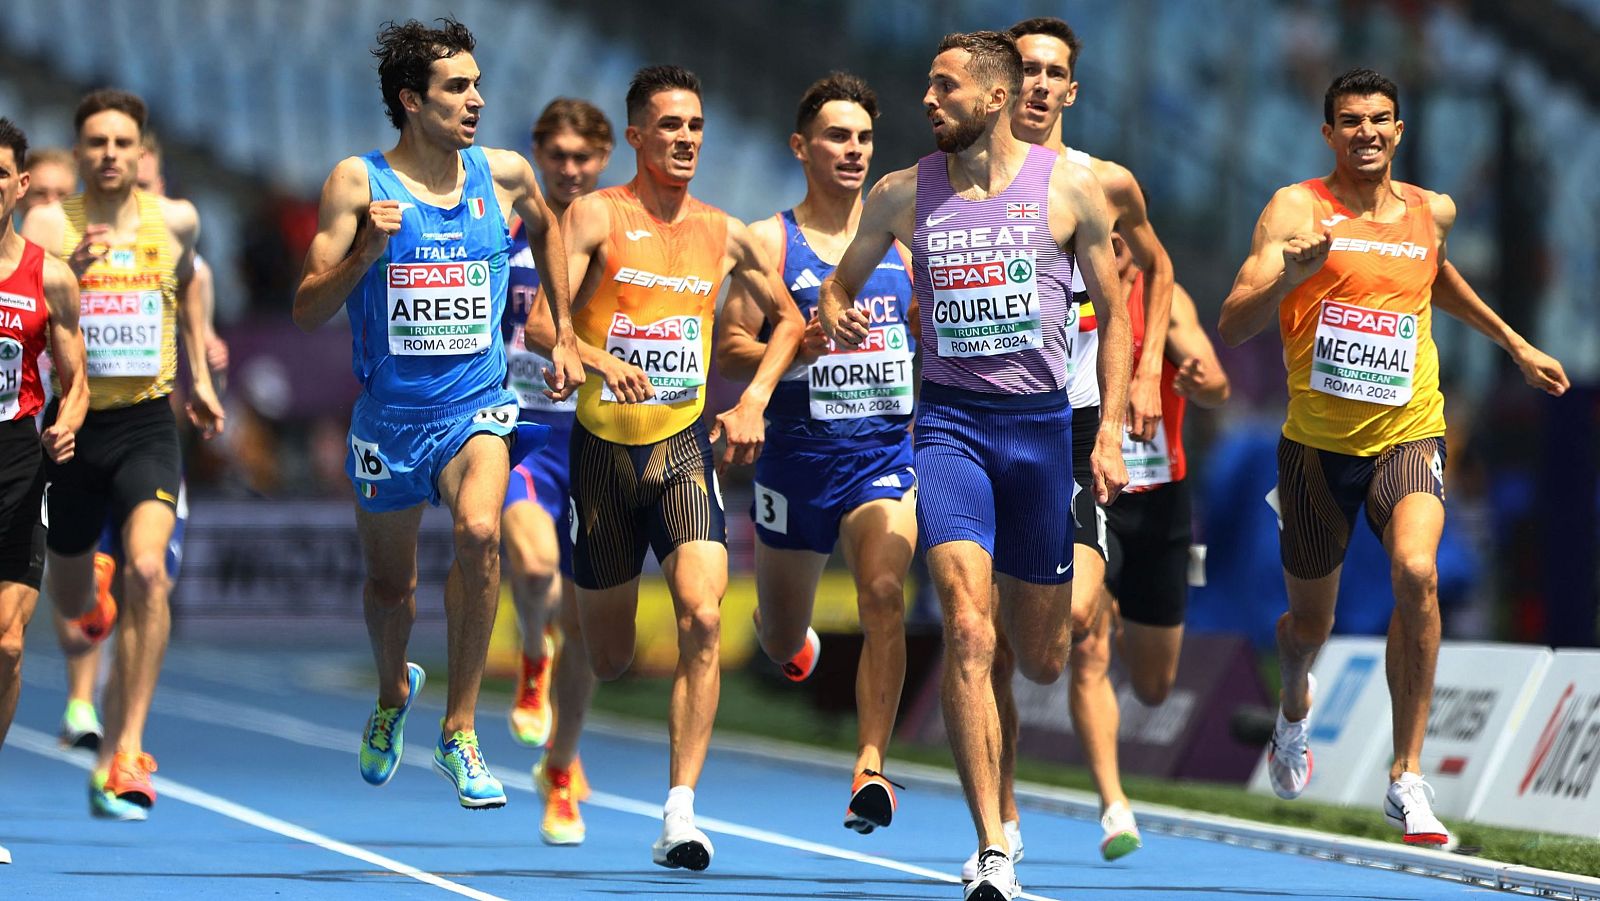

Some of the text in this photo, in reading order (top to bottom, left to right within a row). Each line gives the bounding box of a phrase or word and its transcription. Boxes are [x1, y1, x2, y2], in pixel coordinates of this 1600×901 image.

[928, 226, 1036, 252] GREAT
[1330, 238, 1428, 261] ESPAÑA
[415, 246, 468, 259] ITALIA
[391, 267, 463, 285] SPAR
[613, 267, 713, 296] ESPAÑA
[933, 265, 1004, 287] SPAR
[391, 297, 487, 321] ARESE
[934, 293, 1032, 324] GOURLEY
[1324, 306, 1396, 334] SPAR
[415, 327, 436, 335] RUN
[438, 326, 469, 334] CLEAN
[958, 328, 980, 337] RUN
[981, 325, 1015, 334] CLEAN
[403, 338, 478, 350] ROMA 2024
[951, 334, 1027, 352] ROMA 2024
[1316, 336, 1410, 373] MECHAAL
[609, 346, 699, 373] GARCÍA
[651, 377, 684, 387] CLEAN
[812, 360, 906, 388] MORNET
[1337, 369, 1358, 379] RUN
[1360, 372, 1391, 384] CLEAN
[836, 390, 858, 399] RUN
[860, 388, 890, 398] CLEAN
[1323, 377, 1397, 400] ROMA 2024
[825, 400, 901, 415] ROMA 2024
[354, 444, 383, 476] 16
[762, 493, 777, 524] 3
